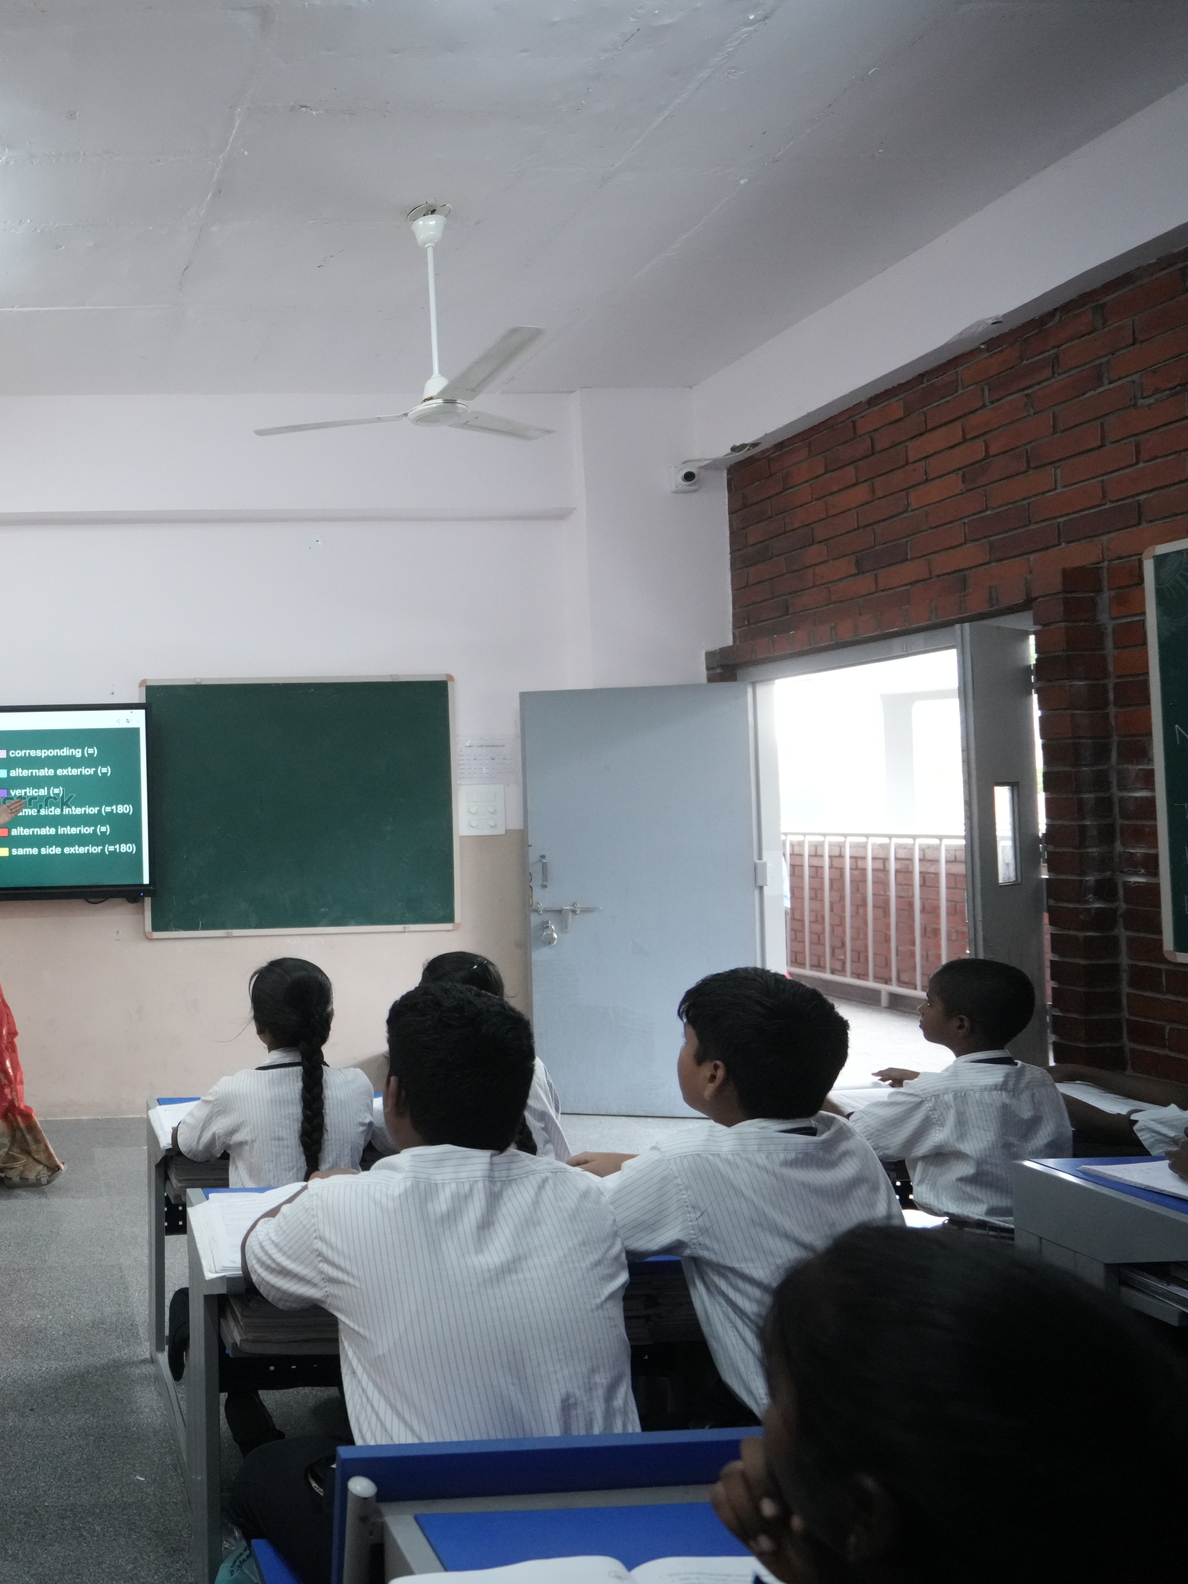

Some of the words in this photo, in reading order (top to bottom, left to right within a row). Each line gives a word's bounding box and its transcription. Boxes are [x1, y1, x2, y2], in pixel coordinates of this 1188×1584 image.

[9, 747, 82, 758] corresponding
[84, 746, 98, 758] (=)
[9, 767, 55, 777] alternate
[56, 766, 96, 776] exterior
[97, 765, 111, 777] (=)
[9, 786, 48, 796] vertical
[49, 786, 63, 797] (=)
[15, 806, 38, 816] ame
[39, 805, 61, 816] side
[62, 805, 100, 815] interior
[101, 804, 133, 816] (=180)
[10, 826, 56, 836] alternate
[57, 825, 95, 835] interior
[96, 824, 110, 836] (=)
[11, 847, 39, 856] same
[40, 845, 62, 855] side
[63, 844, 103, 854] exterior
[104, 843, 136, 855] (=180)
